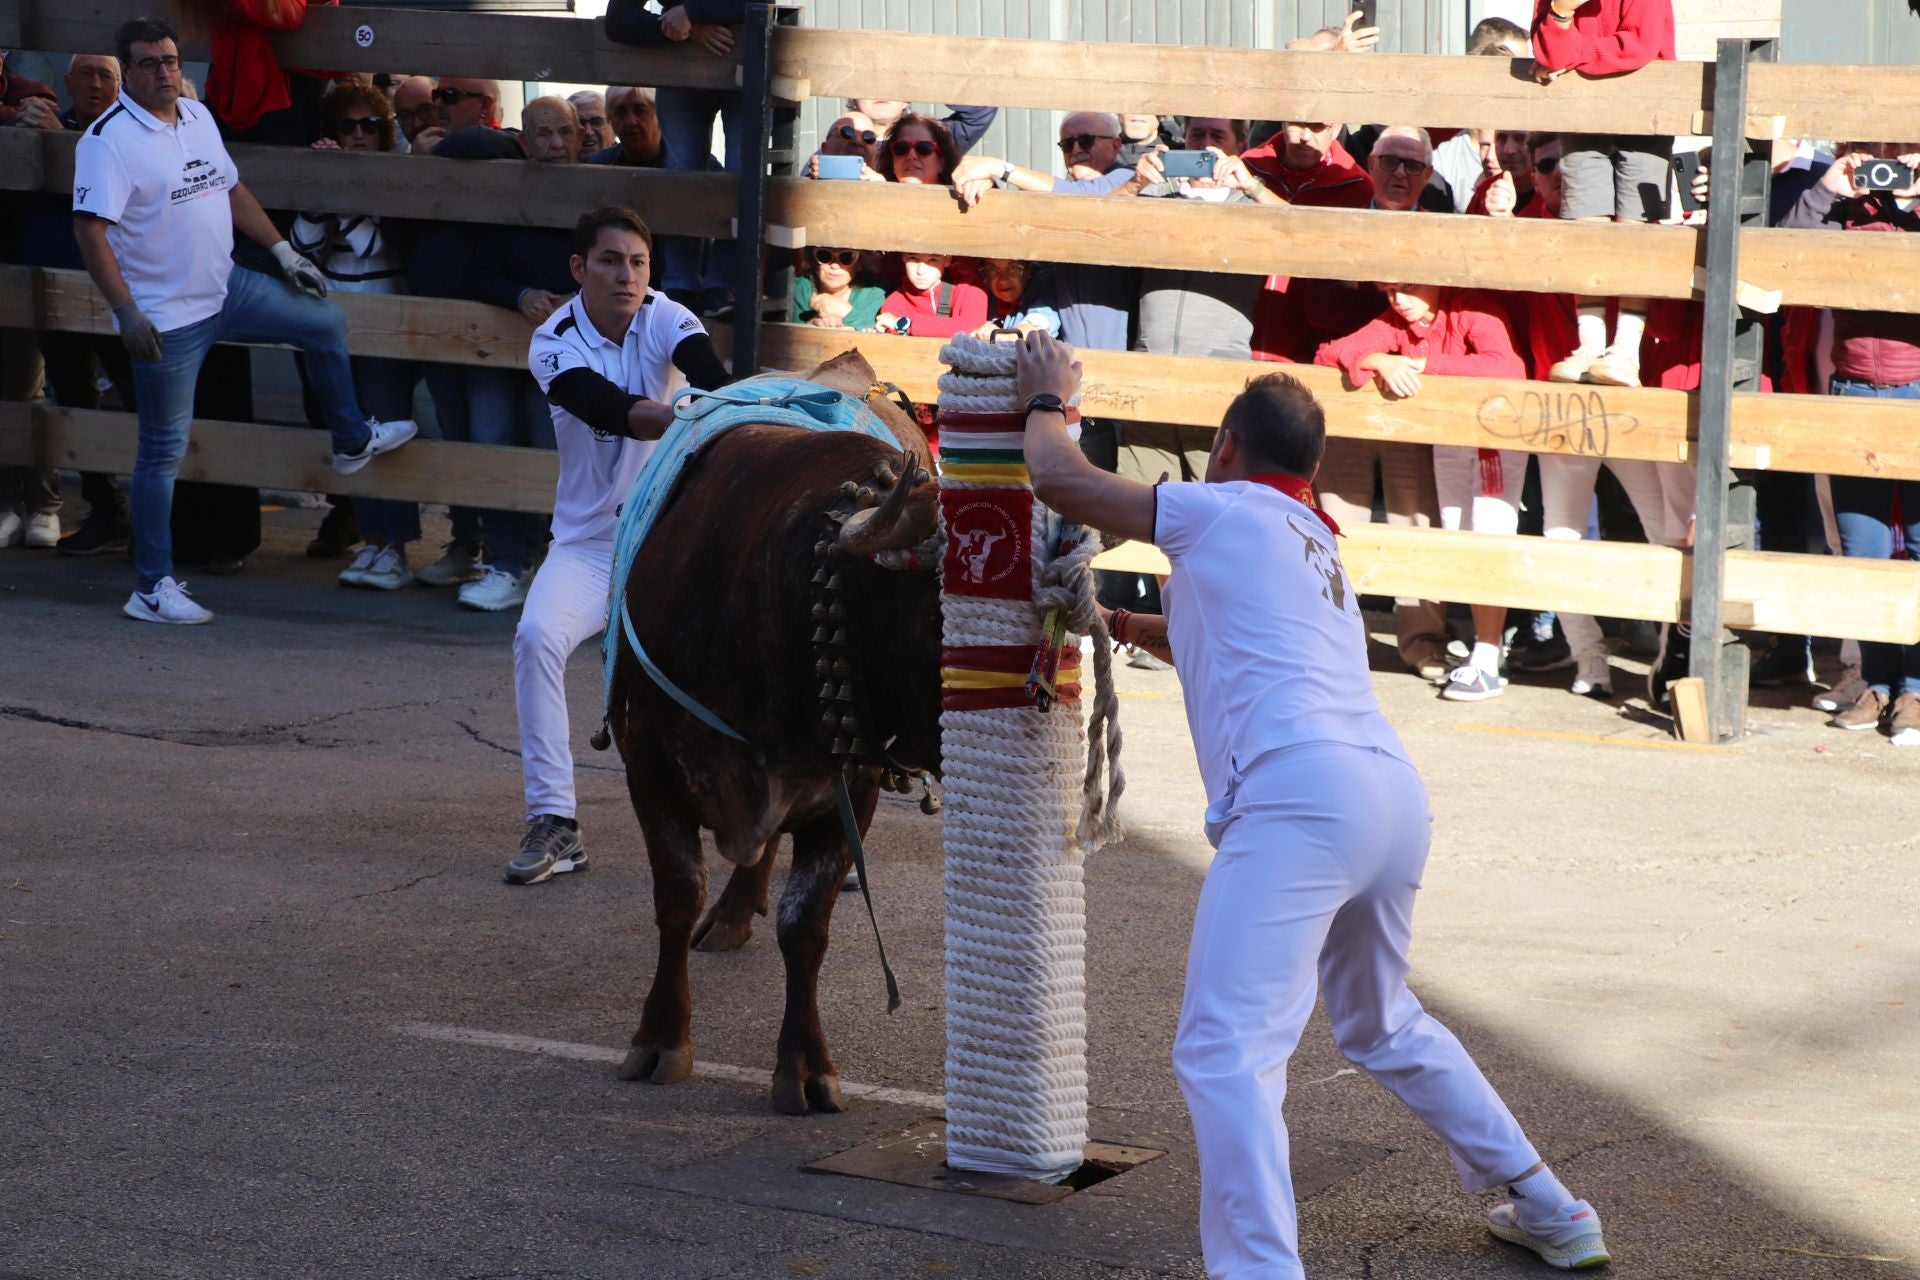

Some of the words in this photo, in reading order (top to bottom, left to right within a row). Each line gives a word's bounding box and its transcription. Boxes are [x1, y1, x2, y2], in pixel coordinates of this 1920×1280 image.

[358, 29, 372, 41] 50
[171, 181, 208, 200] EZQUERRO
[993, 504, 1010, 520] TORO
[1009, 519, 1017, 529] EN
[1014, 529, 1021, 539] LA
[1013, 540, 1022, 564] CALLE
[991, 563, 1015, 582] ARNEDO
